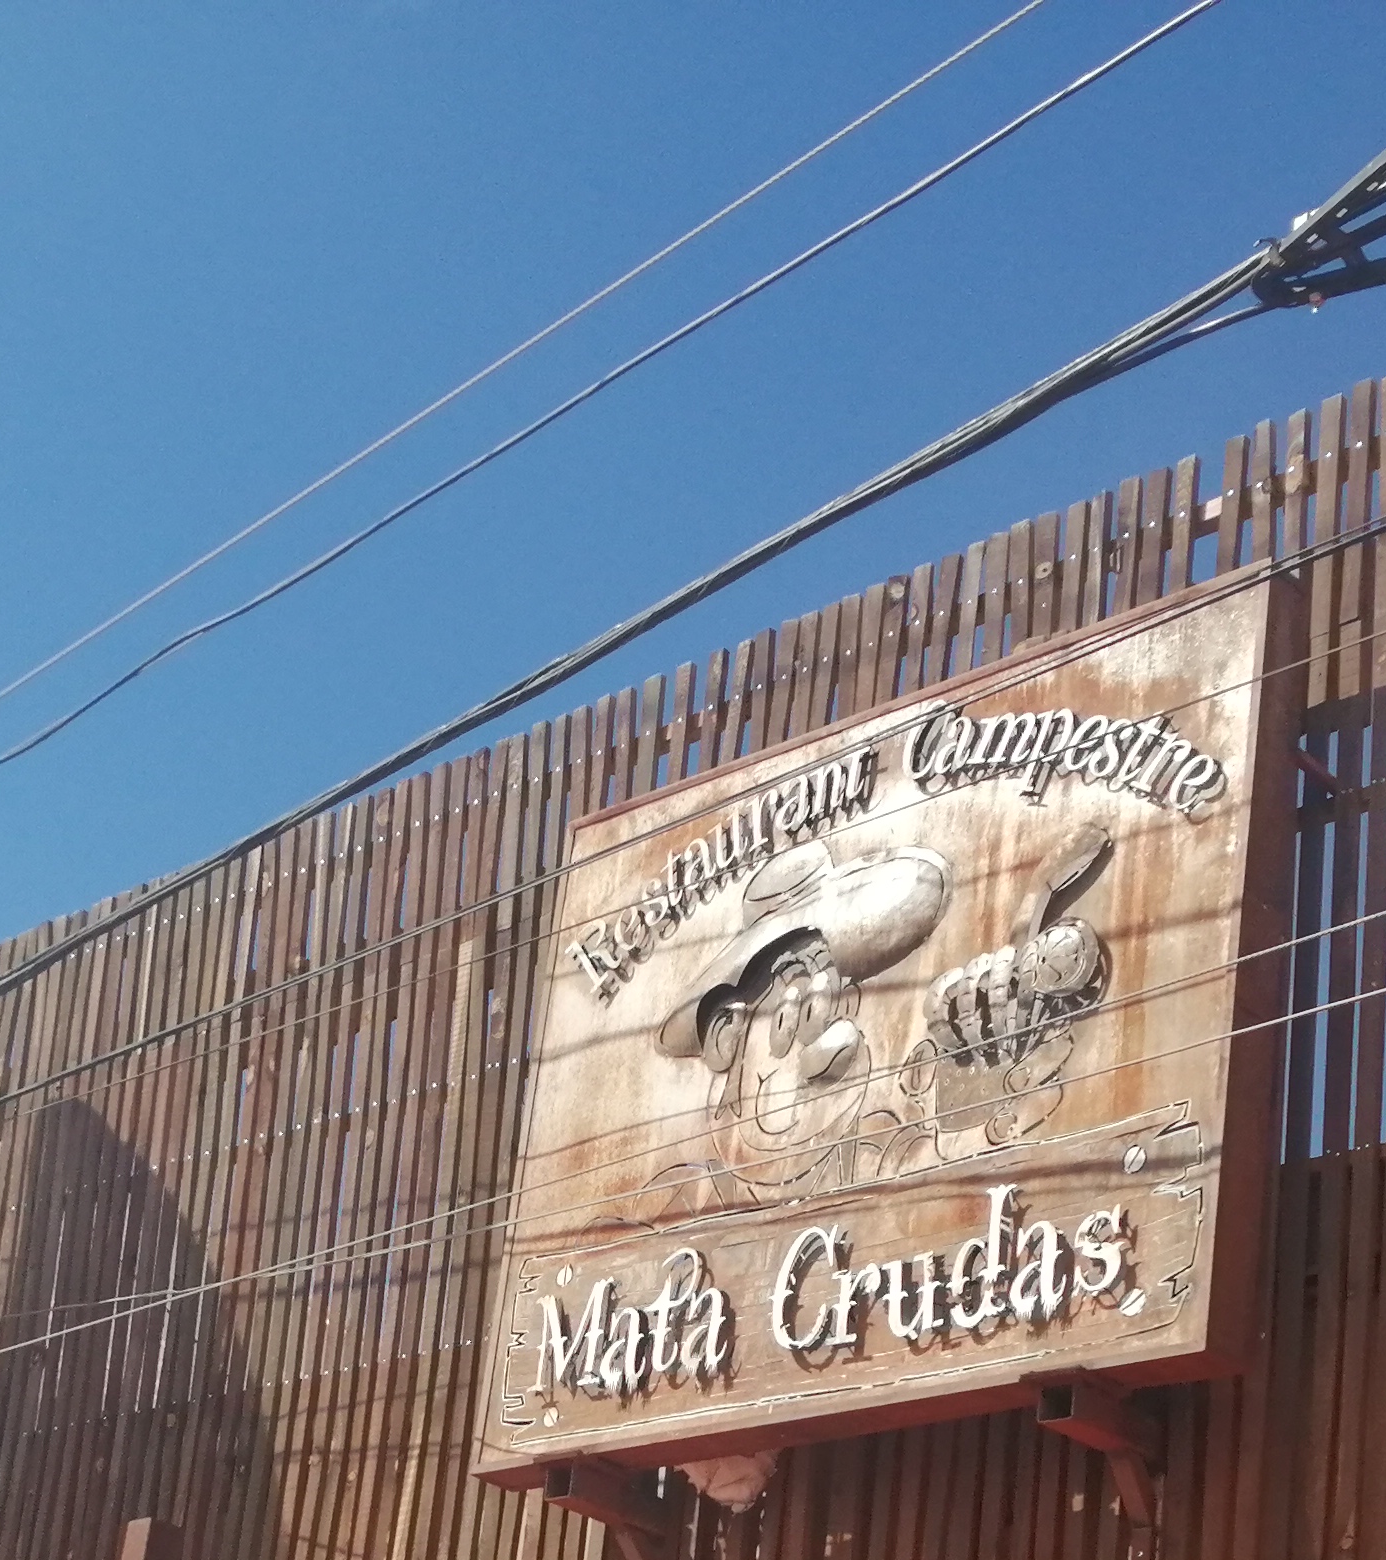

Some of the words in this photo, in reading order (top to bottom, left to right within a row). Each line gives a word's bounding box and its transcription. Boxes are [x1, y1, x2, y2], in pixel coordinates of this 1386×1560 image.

[565, 745, 873, 994] Restaurant
[903, 700, 1218, 806] Campestre
[535, 1247, 730, 1394] Mata
[768, 1182, 1129, 1352] Crudas
